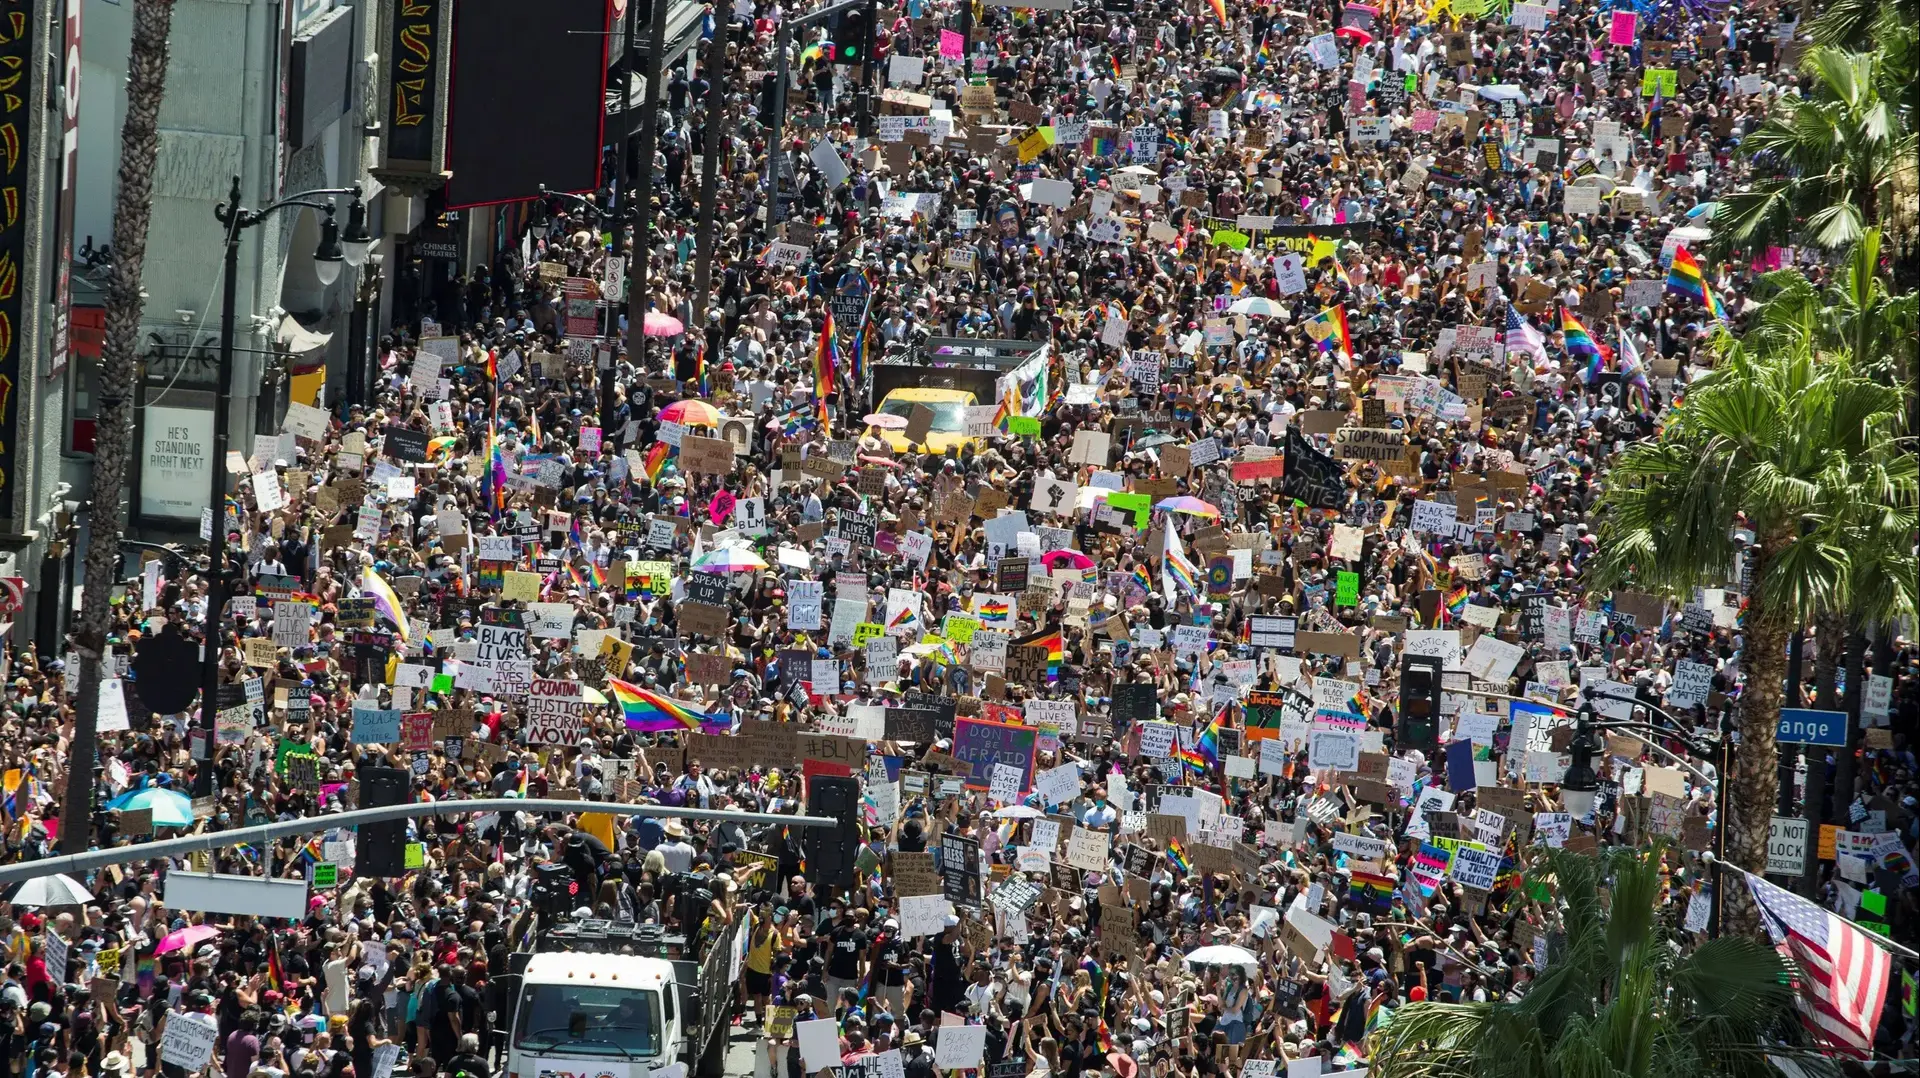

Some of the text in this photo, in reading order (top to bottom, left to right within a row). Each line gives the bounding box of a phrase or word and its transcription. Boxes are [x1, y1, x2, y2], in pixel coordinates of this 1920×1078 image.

[904, 117, 936, 126] BLACK
[1059, 116, 1087, 125] BLACK
[1114, 176, 1135, 184] BLACK
[447, 212, 459, 221] TCL
[423, 242, 457, 251] CHINESE
[830, 297, 865, 306] ALL BLACK
[837, 305, 857, 314] LIVES
[832, 313, 862, 323] MATTER
[1456, 326, 1481, 336] STOP
[1134, 352, 1158, 363] BLACK
[1169, 357, 1191, 369] BLM
[168, 427, 188, 440] HE'S
[968, 423, 997, 436] MATTER
[1336, 429, 1403, 445] STOP POLICE
[155, 441, 200, 456] STANDING
[1343, 446, 1400, 460] BRUTALITY
[151, 455, 204, 469] RIGHT NEXT
[1166, 454, 1186, 466] BLM
[808, 461, 834, 474] BLM
[1419, 504, 1443, 517] BLACK
[738, 518, 764, 530] BLM
[841, 511, 875, 527] ALL BLACK
[1424, 517, 1442, 526] LIVES
[846, 524, 868, 536] LIVES
[1451, 523, 1477, 542] BLM
[842, 531, 872, 545] MATTER
[908, 537, 924, 549] SAY
[481, 539, 510, 551] BLACK
[1464, 555, 1480, 563] LIFE
[627, 562, 670, 571] RACISM
[694, 573, 725, 587] SPEAK
[1020, 594, 1045, 602] BLACK
[1528, 598, 1546, 606] NO
[279, 604, 309, 617] BLACK
[483, 610, 517, 622] BLACK
[1613, 612, 1635, 625] BLM
[279, 620, 305, 633] LIVES
[950, 620, 978, 630] DEFUND
[481, 629, 524, 647] BLACK
[1178, 628, 1194, 637] DARK
[275, 633, 308, 645] MATTER!
[353, 634, 389, 645] LOVE
[874, 640, 895, 652] BLACK
[1409, 639, 1448, 652] JUSTICE
[478, 646, 523, 660] LIVES
[869, 652, 889, 662] Lives
[1007, 646, 1048, 661] DEFUND
[1423, 648, 1439, 656] FOR
[974, 654, 1004, 665] SKIN
[869, 665, 897, 679] MATTER
[1679, 662, 1712, 672] BLACK
[1678, 672, 1709, 682] TRANS
[530, 681, 582, 696] CRIMINAL
[1317, 680, 1356, 690] LATINOS FOR
[1481, 683, 1509, 693] STAND
[1677, 681, 1708, 692] LIVES
[289, 688, 310, 698] BLACK
[1323, 688, 1344, 697] BLACK
[290, 700, 309, 708] LIVES
[1250, 693, 1283, 706] Justice
[1325, 696, 1344, 704] LIVES
[530, 699, 582, 718] JUSTICE
[1029, 702, 1074, 711] ALL BLACK
[1320, 703, 1344, 711] MATTER
[287, 709, 310, 720] MATTER
[363, 713, 397, 724] BLACK
[530, 713, 581, 728] REFORM
[889, 711, 920, 722] BLACK
[1040, 712, 1066, 721] LIVES
[1326, 714, 1359, 725] BLACK
[528, 726, 581, 744] NOW
[970, 724, 1017, 738] DON'T
[1781, 718, 1829, 740] ange
[357, 733, 392, 742] MATTER
[984, 740, 1000, 750] BE
[956, 749, 1026, 765] AFRAID
[870, 759, 883, 768] WE
[870, 768, 886, 777] ARE
[996, 765, 1018, 776] ALL
[1037, 769, 1060, 782] BLACK
[993, 775, 1021, 784] BLACK
[992, 781, 1018, 791] LIVES
[1050, 782, 1077, 797] MATTER
[1156, 786, 1192, 798] BLACK
[990, 789, 1016, 800] MATTER
[1310, 798, 1338, 822] BLM
[1221, 816, 1239, 829] YES
[1478, 811, 1504, 828] BLACK
[1084, 831, 1108, 842] BLACK
[1783, 826, 1804, 840] NOT
[953, 840, 964, 849] GOD
[1077, 842, 1099, 853] LIVES
[1770, 843, 1802, 857] LOCK
[944, 849, 964, 863] BLESS
[1069, 853, 1104, 866] MATTER
[1421, 850, 1449, 862] BLACK
[1459, 850, 1500, 865] EQUALITY
[1417, 862, 1444, 874] LIVES
[1467, 862, 1496, 875] JUSTICE
[1006, 920, 1013, 930] A
[1102, 940, 1128, 951] BLM
[944, 1032, 973, 1044] BLACK
[991, 1065, 1024, 1076] BLACK
[1245, 1060, 1269, 1072] BLACK
